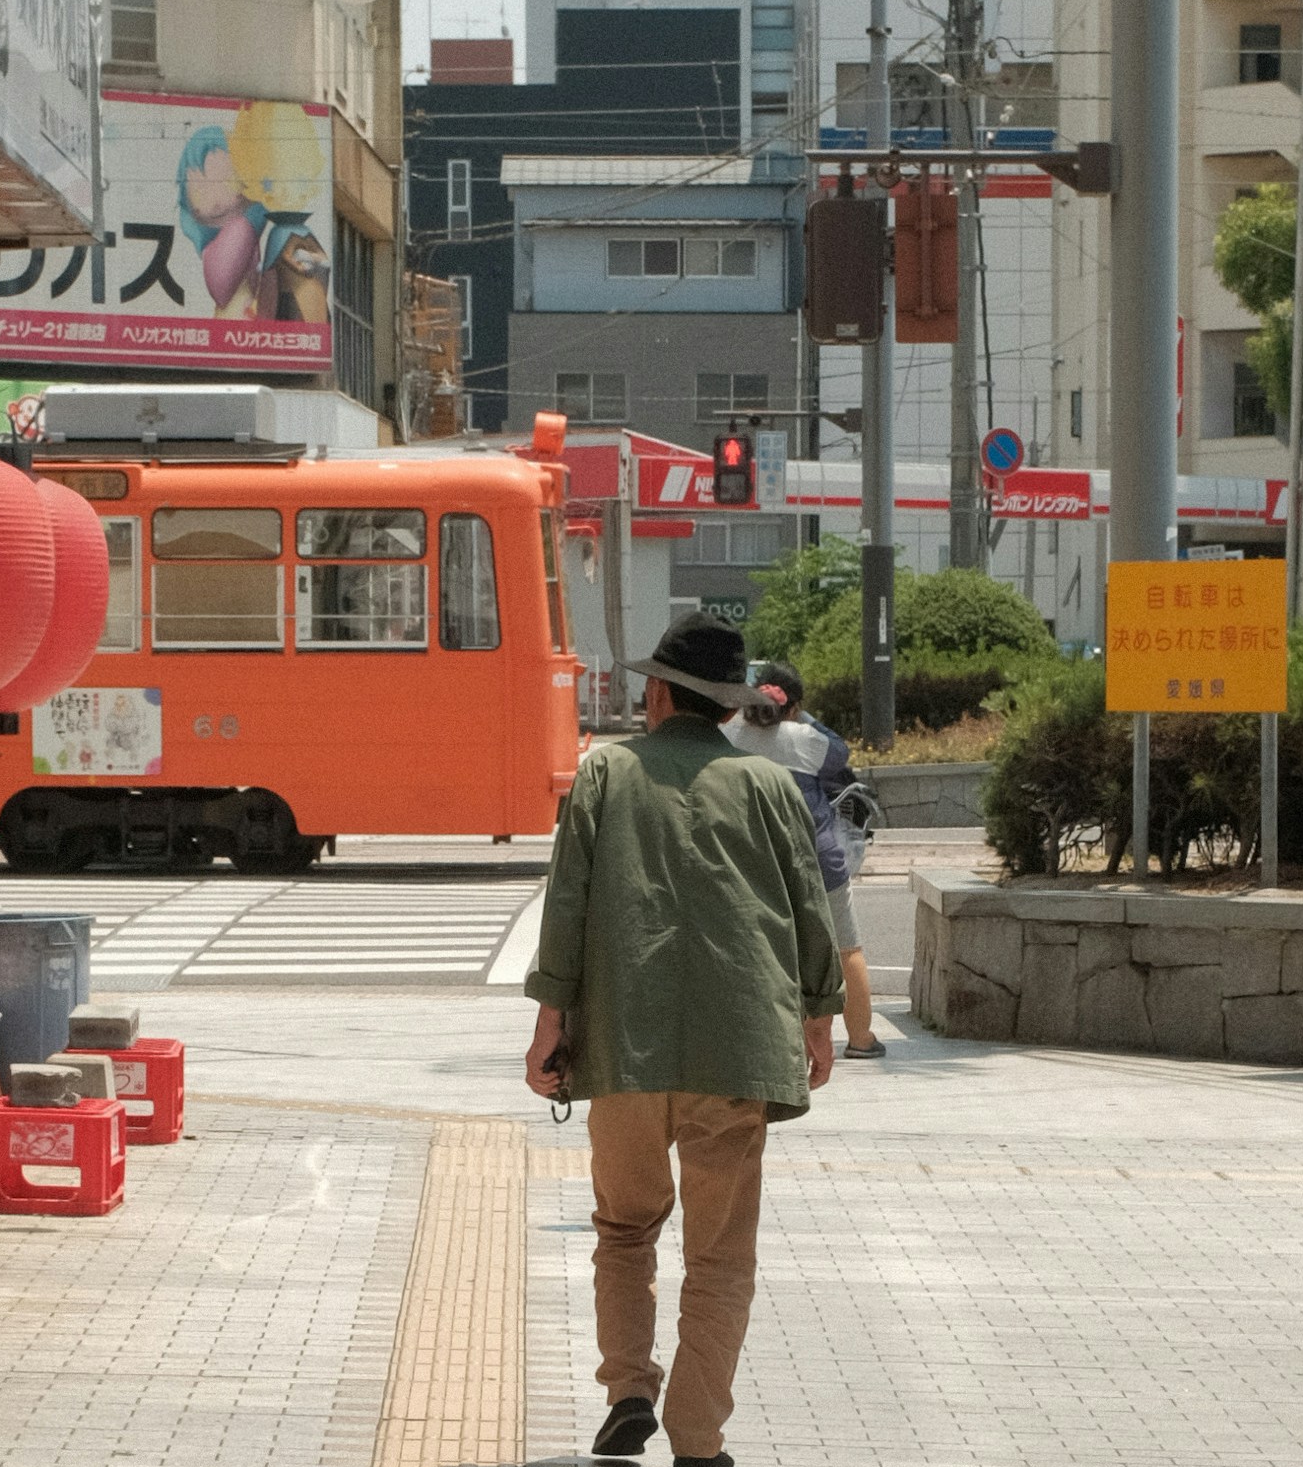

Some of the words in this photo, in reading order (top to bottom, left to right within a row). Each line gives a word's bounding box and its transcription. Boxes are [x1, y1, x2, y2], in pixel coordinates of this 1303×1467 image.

[1147, 584, 1246, 610] 自転車は
[1111, 625, 1282, 653] 決められた場所に
[1167, 678, 1226, 700] 愛媛県
